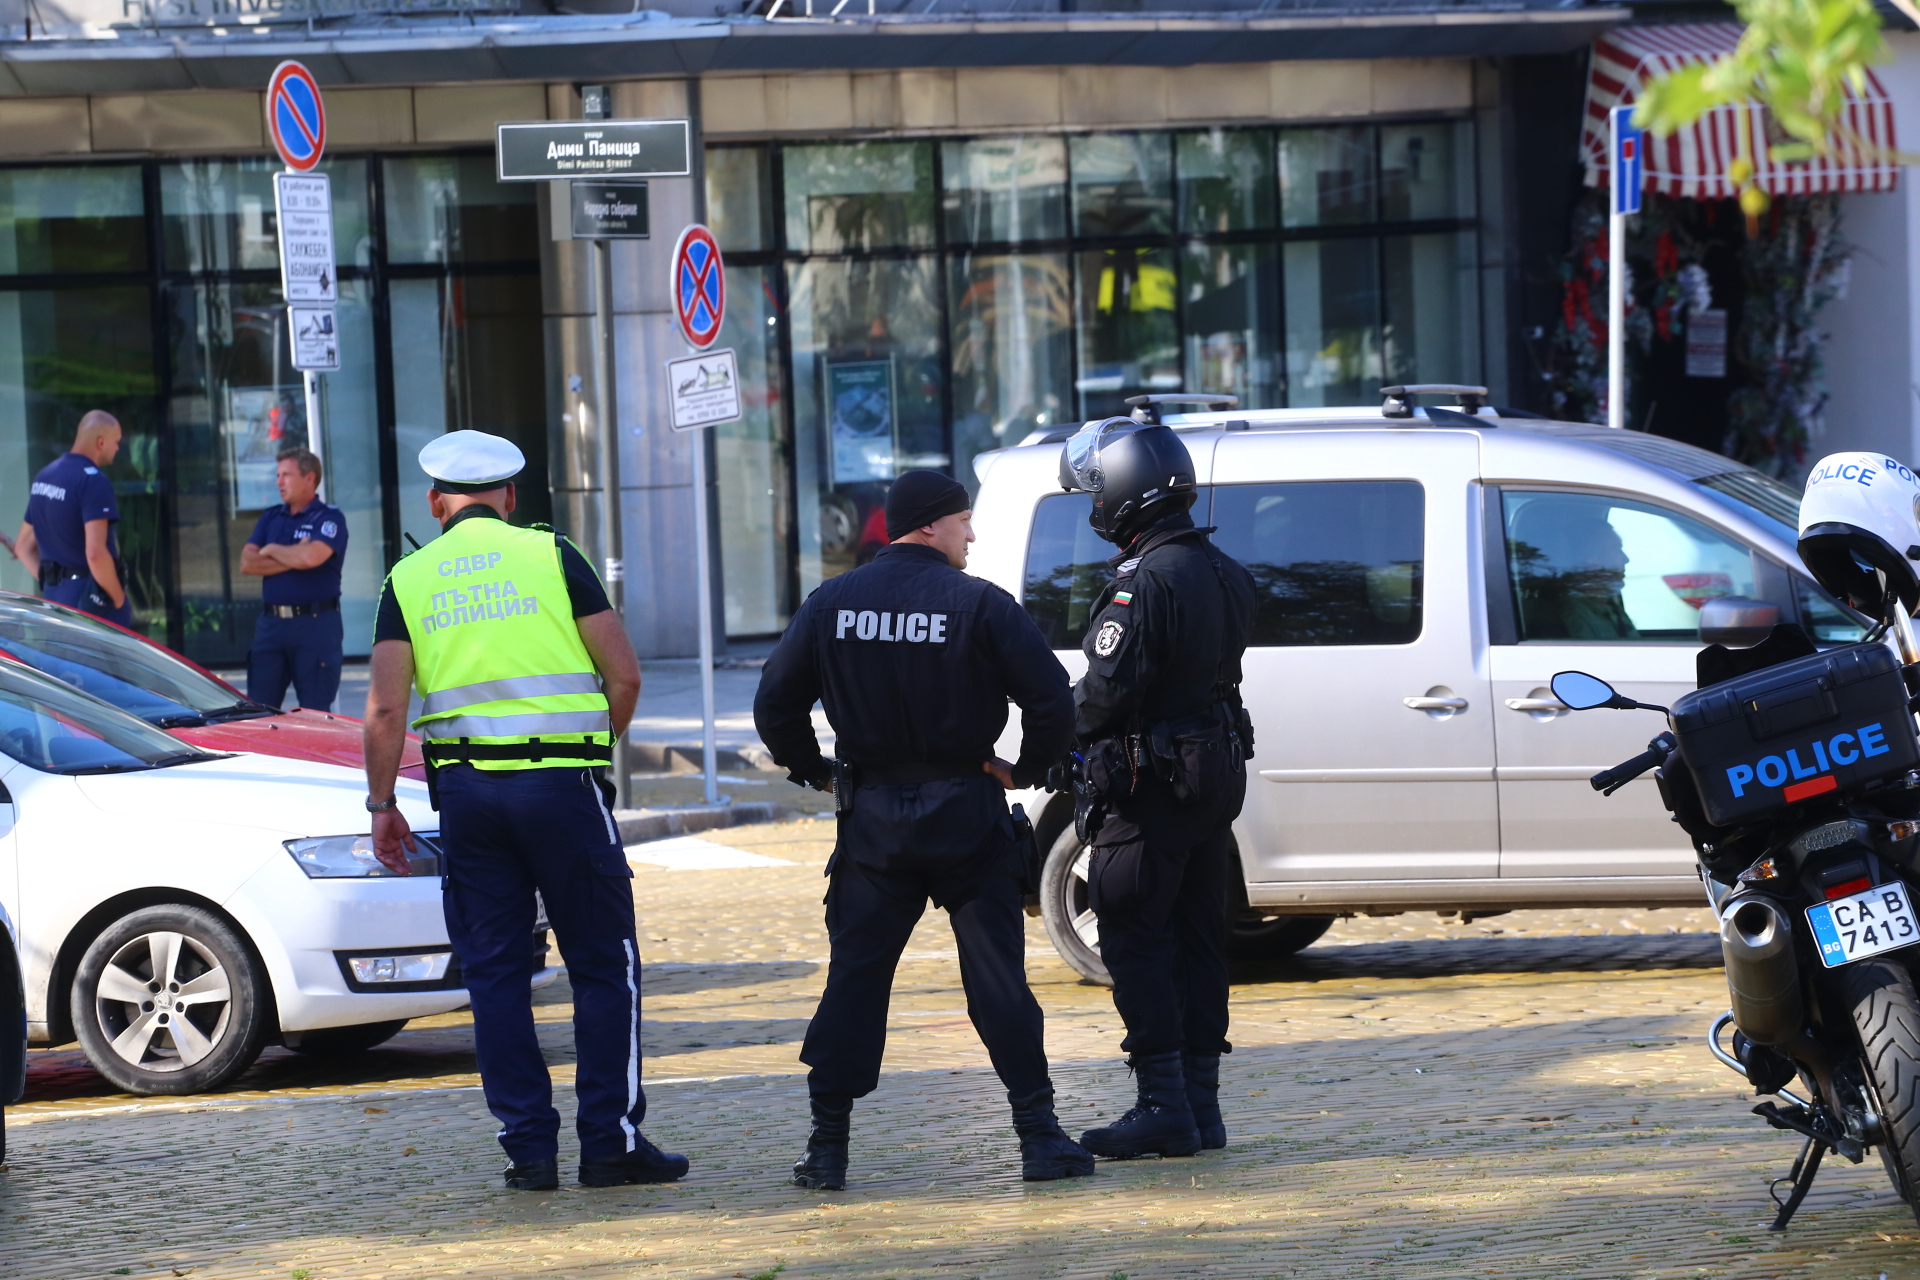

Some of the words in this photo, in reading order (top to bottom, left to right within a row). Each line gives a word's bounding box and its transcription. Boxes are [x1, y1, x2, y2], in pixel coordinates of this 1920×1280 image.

[547, 141, 583, 159] Дими
[589, 140, 640, 157] Паница
[557, 160, 574, 169] Dimi
[31, 482, 66, 501] ОЛИЦИЯ
[438, 552, 501, 577] СДВР
[431, 580, 518, 610] ПЪТНА
[421, 596, 538, 634] ПОЛИЦИЯ
[836, 609, 947, 643] POLICE
[1726, 722, 1890, 798] POLICE
[1823, 941, 1841, 955] BG
[1842, 916, 1913, 953] 7413
